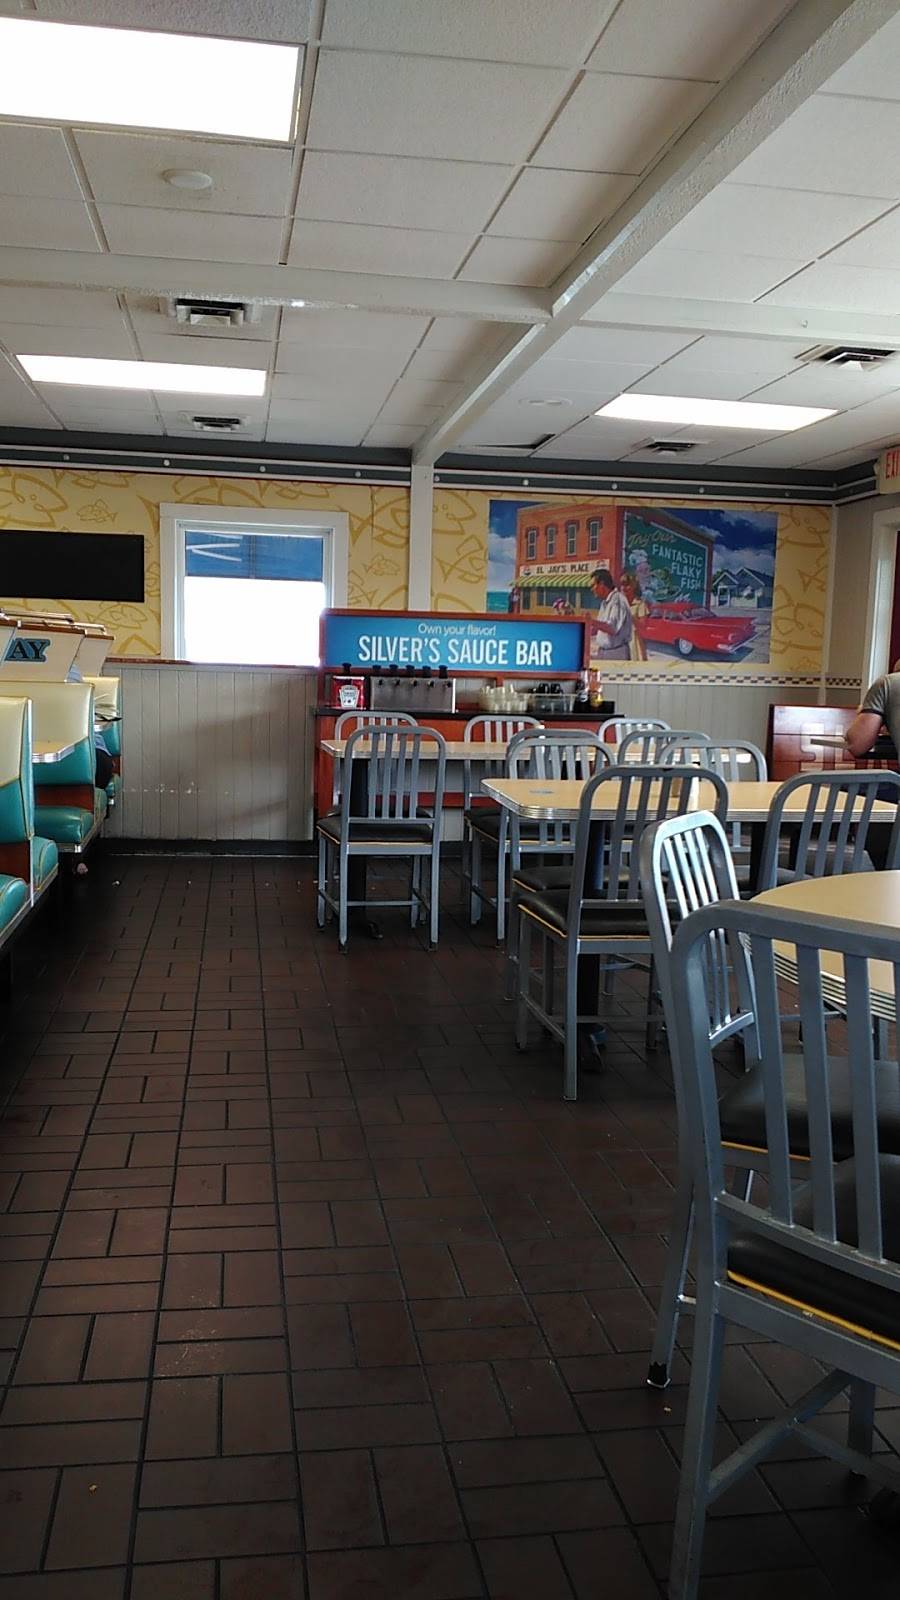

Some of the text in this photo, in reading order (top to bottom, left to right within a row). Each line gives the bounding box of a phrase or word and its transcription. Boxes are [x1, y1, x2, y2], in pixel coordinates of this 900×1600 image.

[886, 450, 900, 479] EXI
[652, 530, 677, 543] Our
[652, 544, 703, 567] FANTASTIC
[548, 564, 567, 574] JAY'S
[570, 563, 589, 573] PLACE
[671, 562, 702, 579] FLAKY
[680, 577, 702, 590] FISH
[418, 622, 496, 637] Own your flavor!
[358, 635, 553, 667] SILVER'S SAUCE BAR
